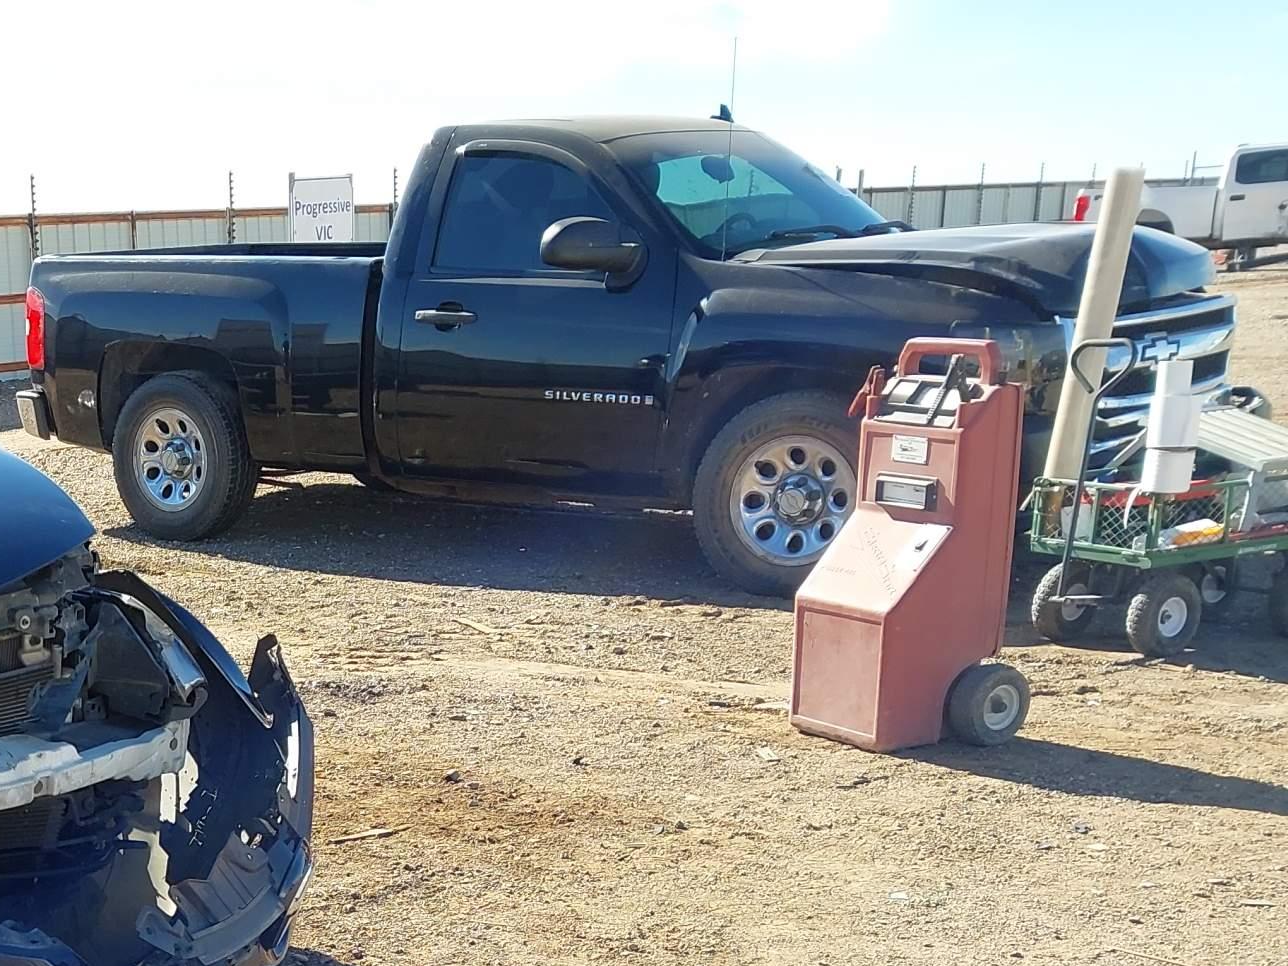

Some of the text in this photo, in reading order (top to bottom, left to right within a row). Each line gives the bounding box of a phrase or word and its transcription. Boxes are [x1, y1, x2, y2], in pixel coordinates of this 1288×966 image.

[295, 197, 351, 218] Progressive
[315, 225, 333, 241] VIC
[543, 389, 640, 404] SILVERADO
